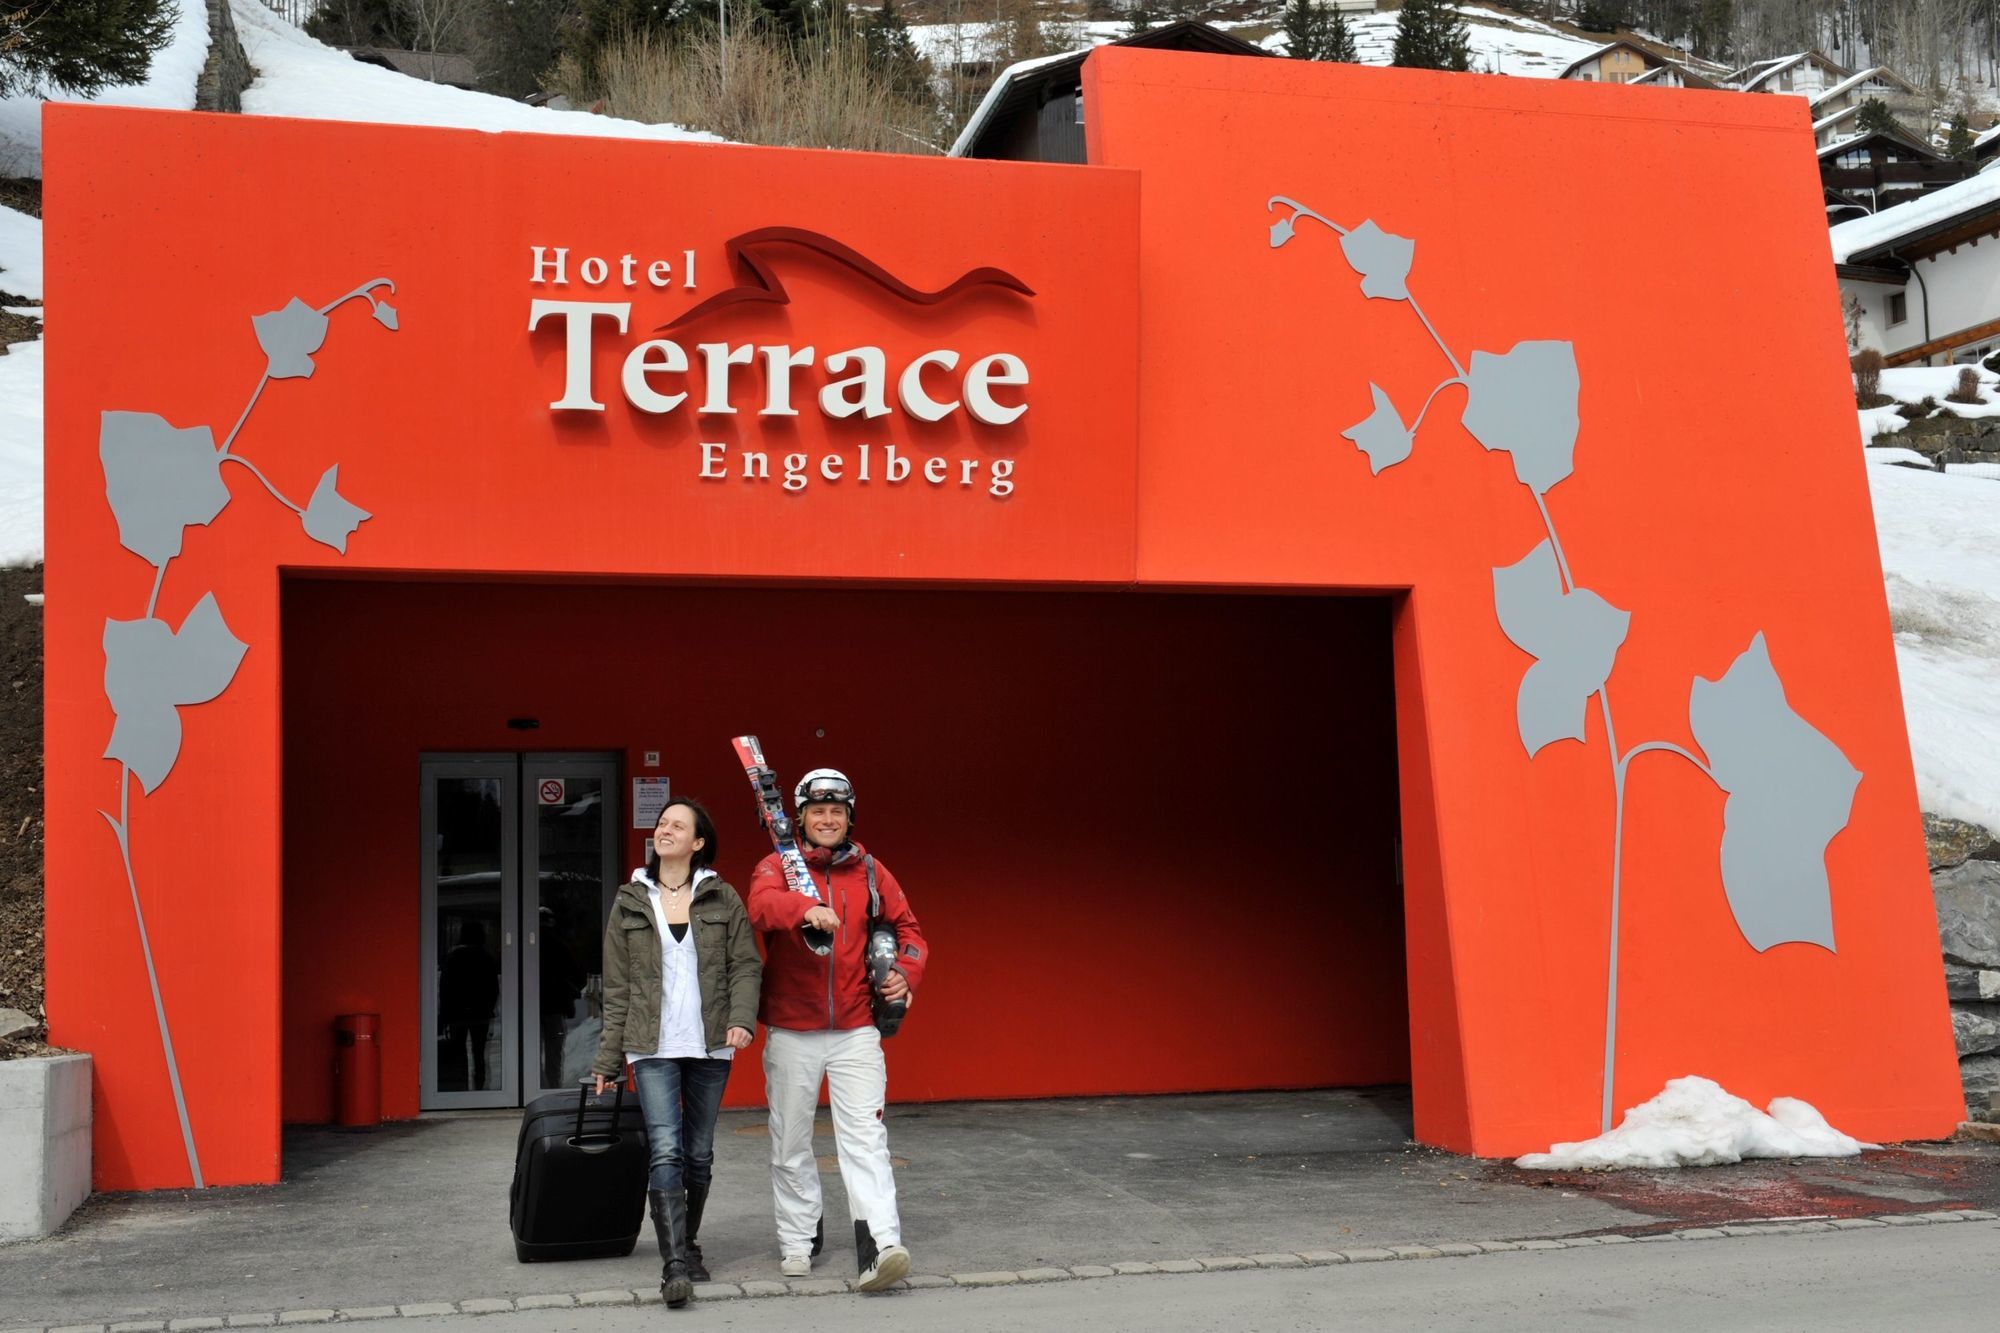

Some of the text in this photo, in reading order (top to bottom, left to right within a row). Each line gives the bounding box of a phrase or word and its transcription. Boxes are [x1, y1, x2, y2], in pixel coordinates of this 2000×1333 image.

[529, 246, 697, 288] Hotel
[528, 298, 1029, 425] Terrace
[699, 442, 1015, 496] Engelberg
